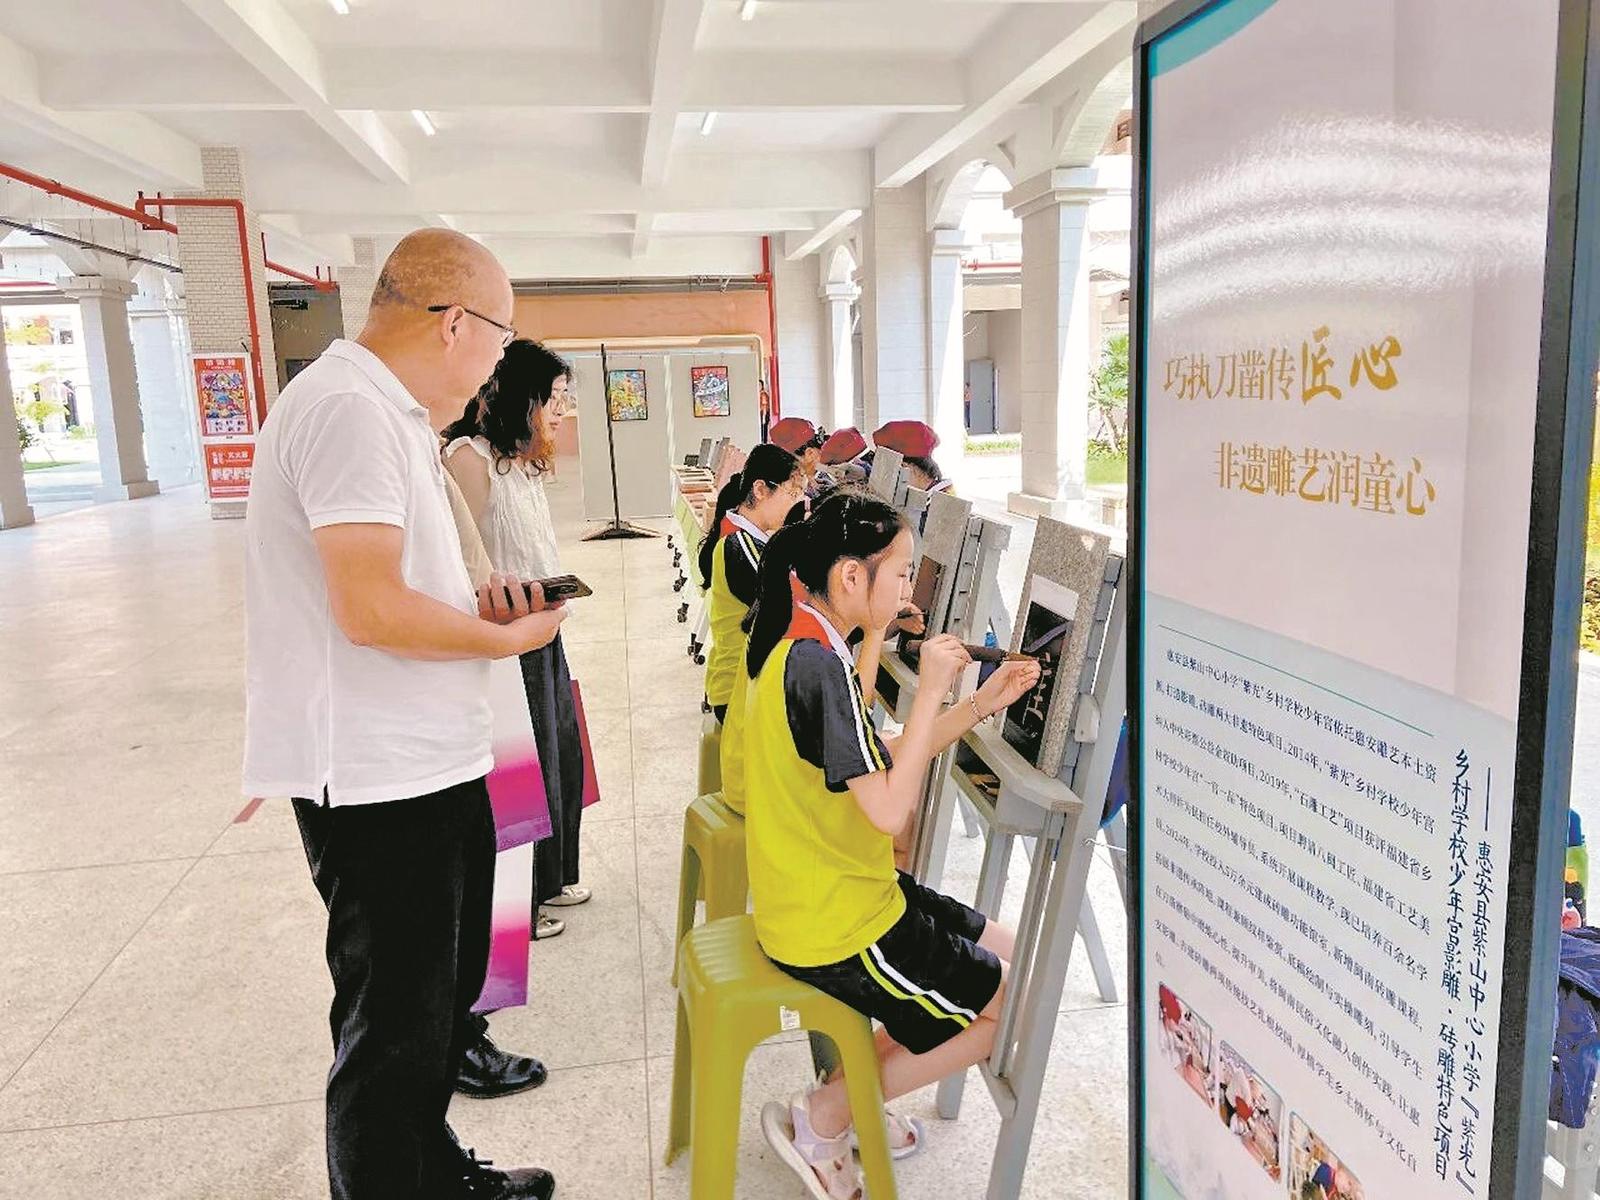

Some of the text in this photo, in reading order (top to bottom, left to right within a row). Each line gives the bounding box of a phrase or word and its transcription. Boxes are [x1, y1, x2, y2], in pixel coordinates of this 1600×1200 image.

[1163, 325, 1402, 405] 巧执刀凿传匠心
[1213, 441, 1436, 516] 非遗雕艺润童心
